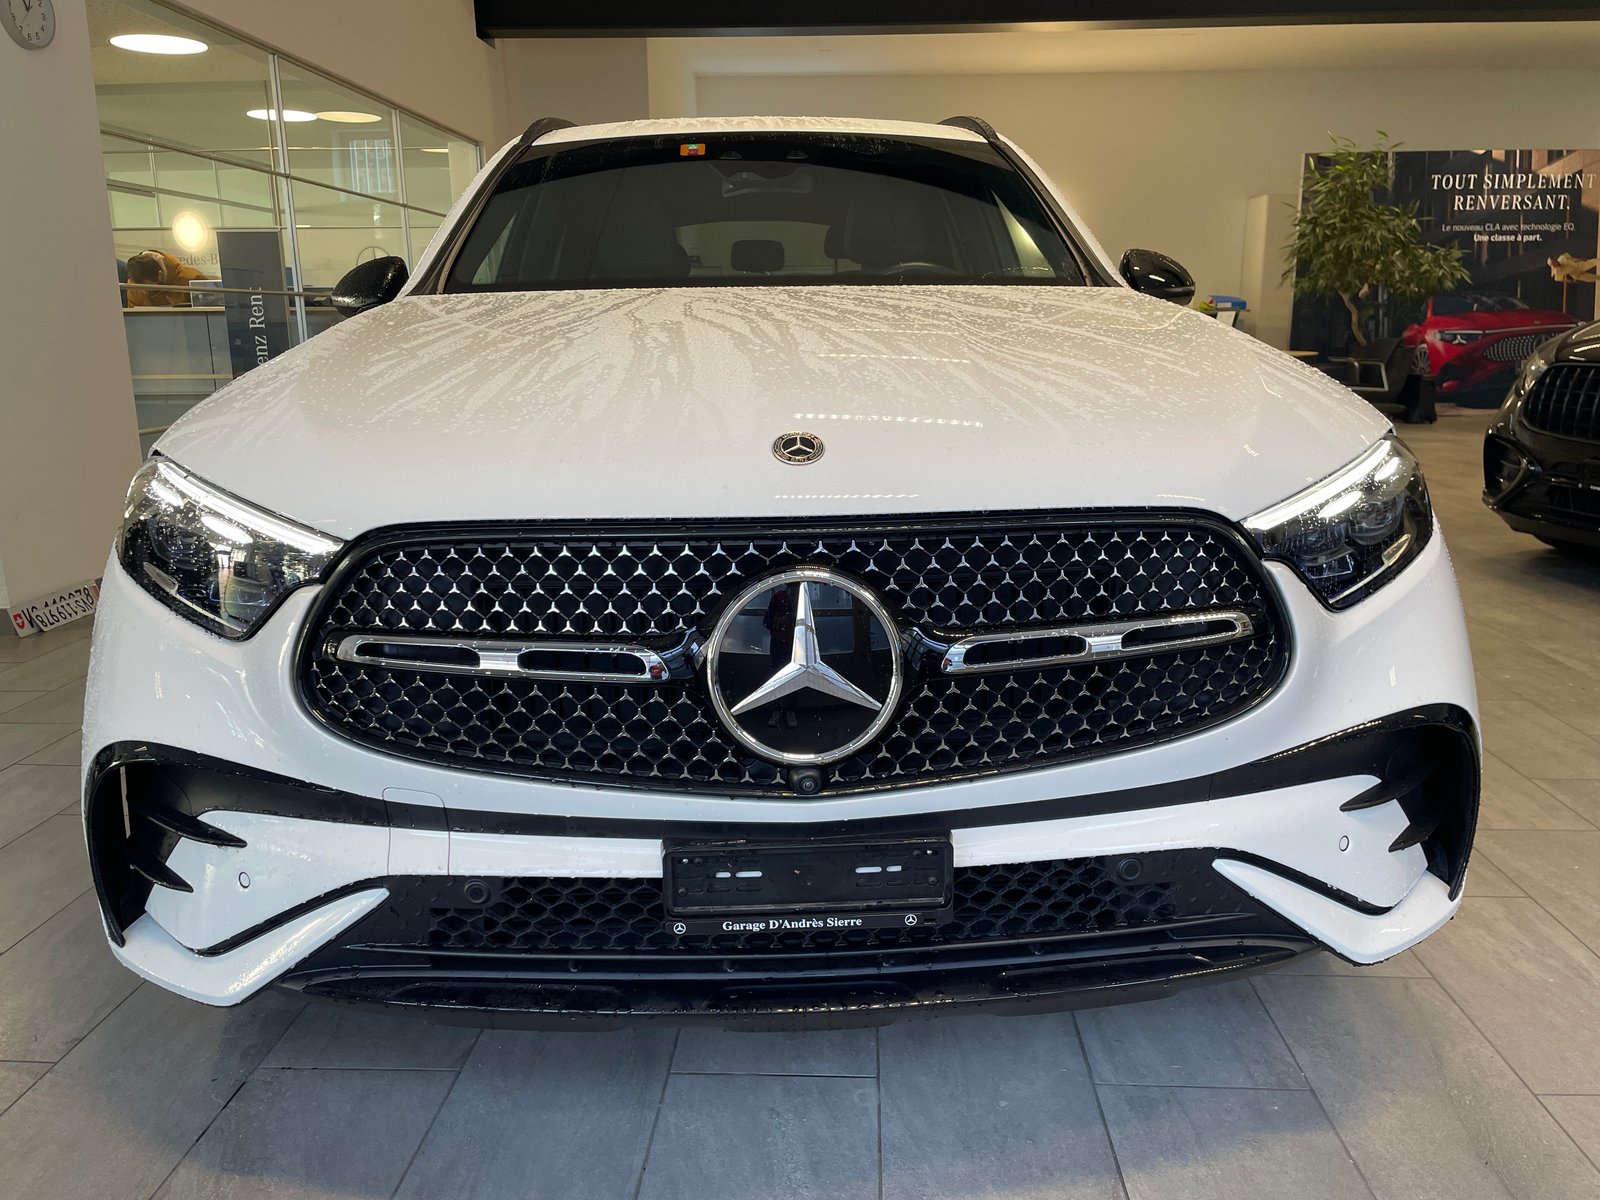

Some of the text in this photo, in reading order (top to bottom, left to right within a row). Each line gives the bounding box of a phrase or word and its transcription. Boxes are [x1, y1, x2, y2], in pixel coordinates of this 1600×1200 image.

[1431, 173, 1597, 190] TOUT SIMPLEMENT
[1453, 194, 1571, 211] RENVERSANT.
[1441, 224, 1451, 232] Le
[1452, 224, 1484, 232] nouveau
[1485, 223, 1500, 231] CLA
[1520, 222, 1562, 232] technologie
[1473, 233, 1542, 242] Une classe à part.
[722, 917, 863, 932] Garage D'Andrès Sierre
